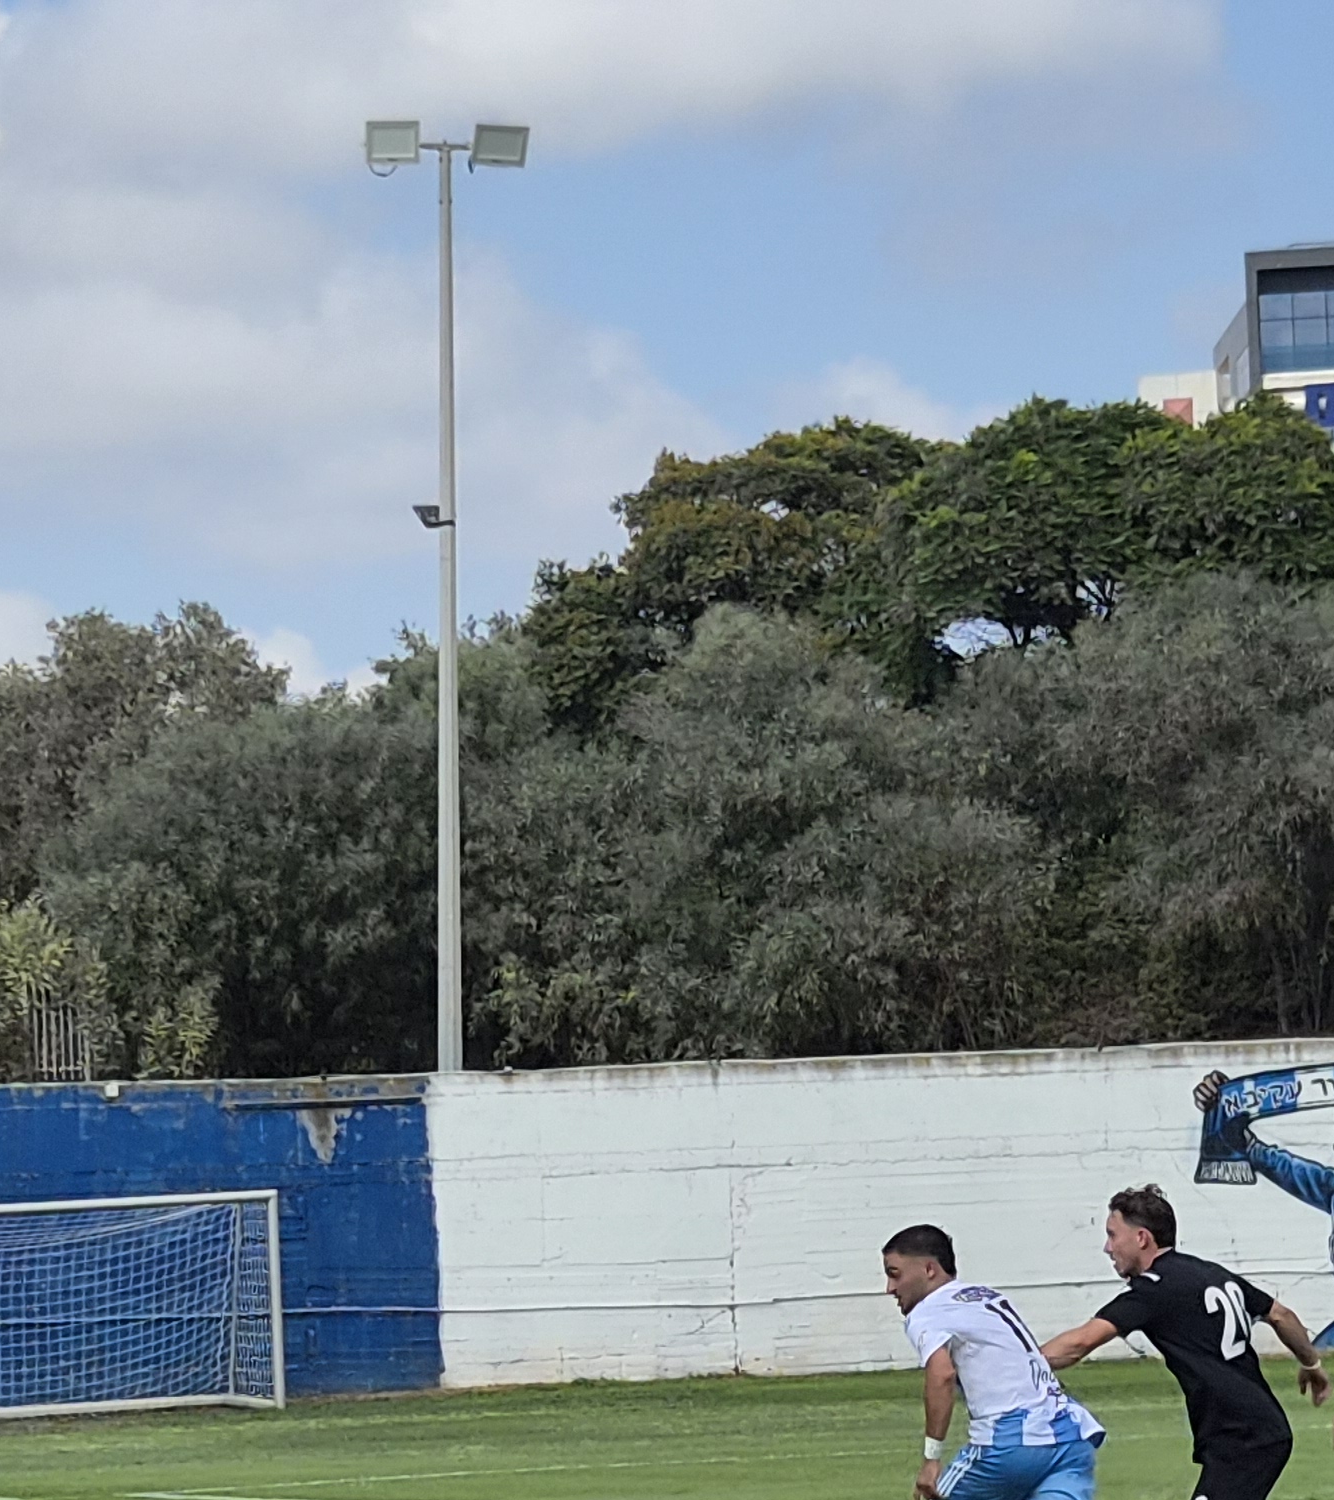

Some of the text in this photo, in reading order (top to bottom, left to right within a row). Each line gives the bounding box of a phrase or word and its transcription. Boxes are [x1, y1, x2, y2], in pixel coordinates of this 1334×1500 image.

[1223, 1081, 1303, 1118] עקיבא
[985, 1299, 1042, 1353] 11
[1204, 1281, 1252, 1361] 20
